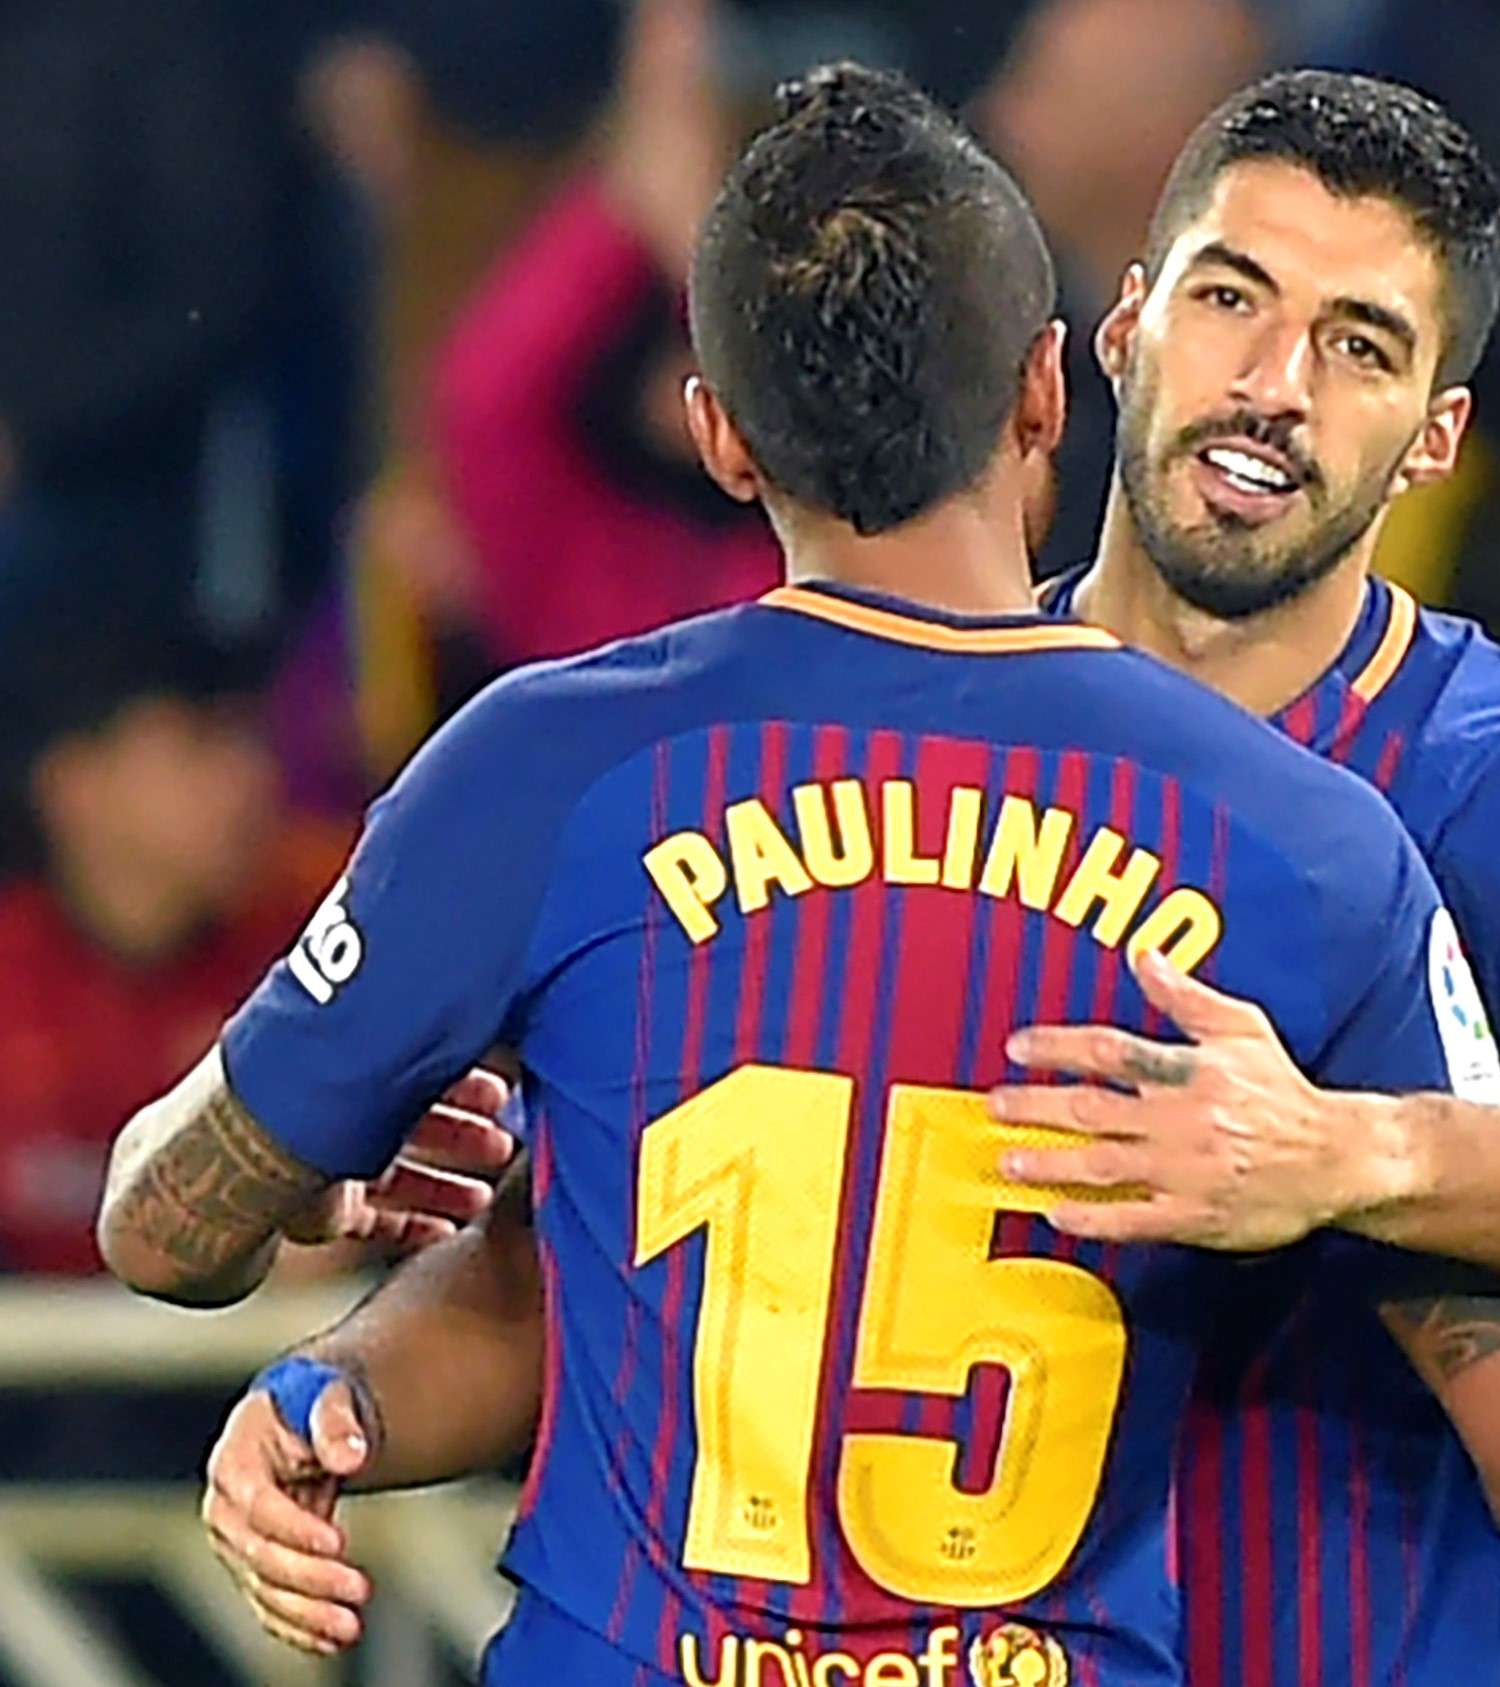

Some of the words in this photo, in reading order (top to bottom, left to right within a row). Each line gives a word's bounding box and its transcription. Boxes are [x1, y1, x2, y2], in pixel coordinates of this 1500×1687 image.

[643, 778, 1221, 976] PAULINHO
[635, 1063, 1127, 1606] 15
[681, 1626, 960, 1687] unicef
